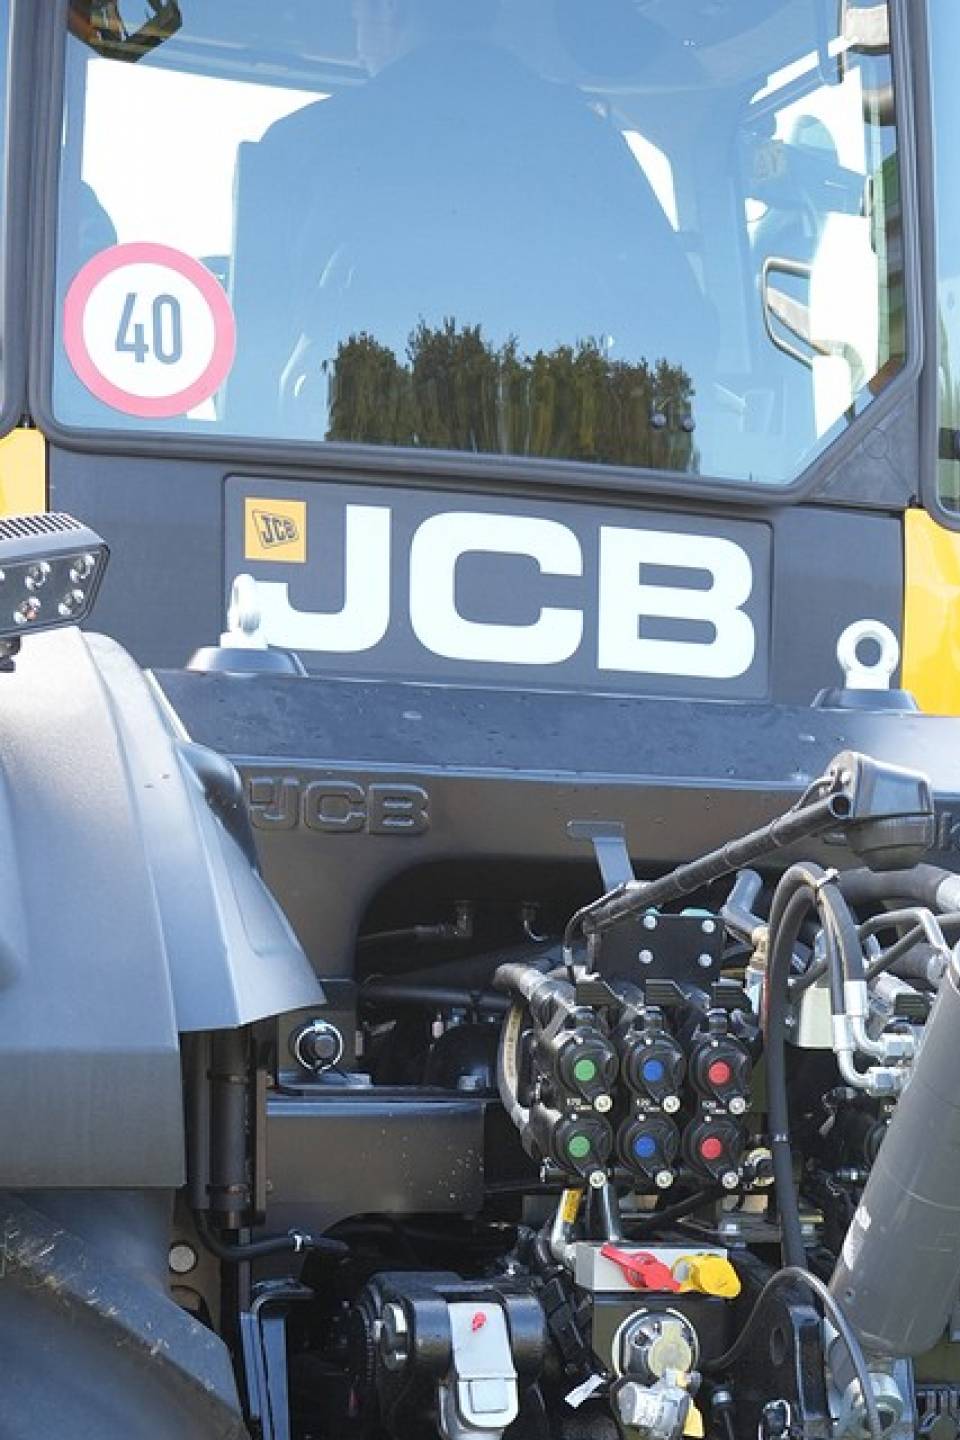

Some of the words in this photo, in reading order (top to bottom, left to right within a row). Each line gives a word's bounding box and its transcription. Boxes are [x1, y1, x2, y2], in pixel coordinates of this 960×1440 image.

[115, 292, 182, 365] 40
[261, 515, 296, 543] JCB
[256, 504, 756, 679] JCB
[249, 776, 430, 836] JCB
